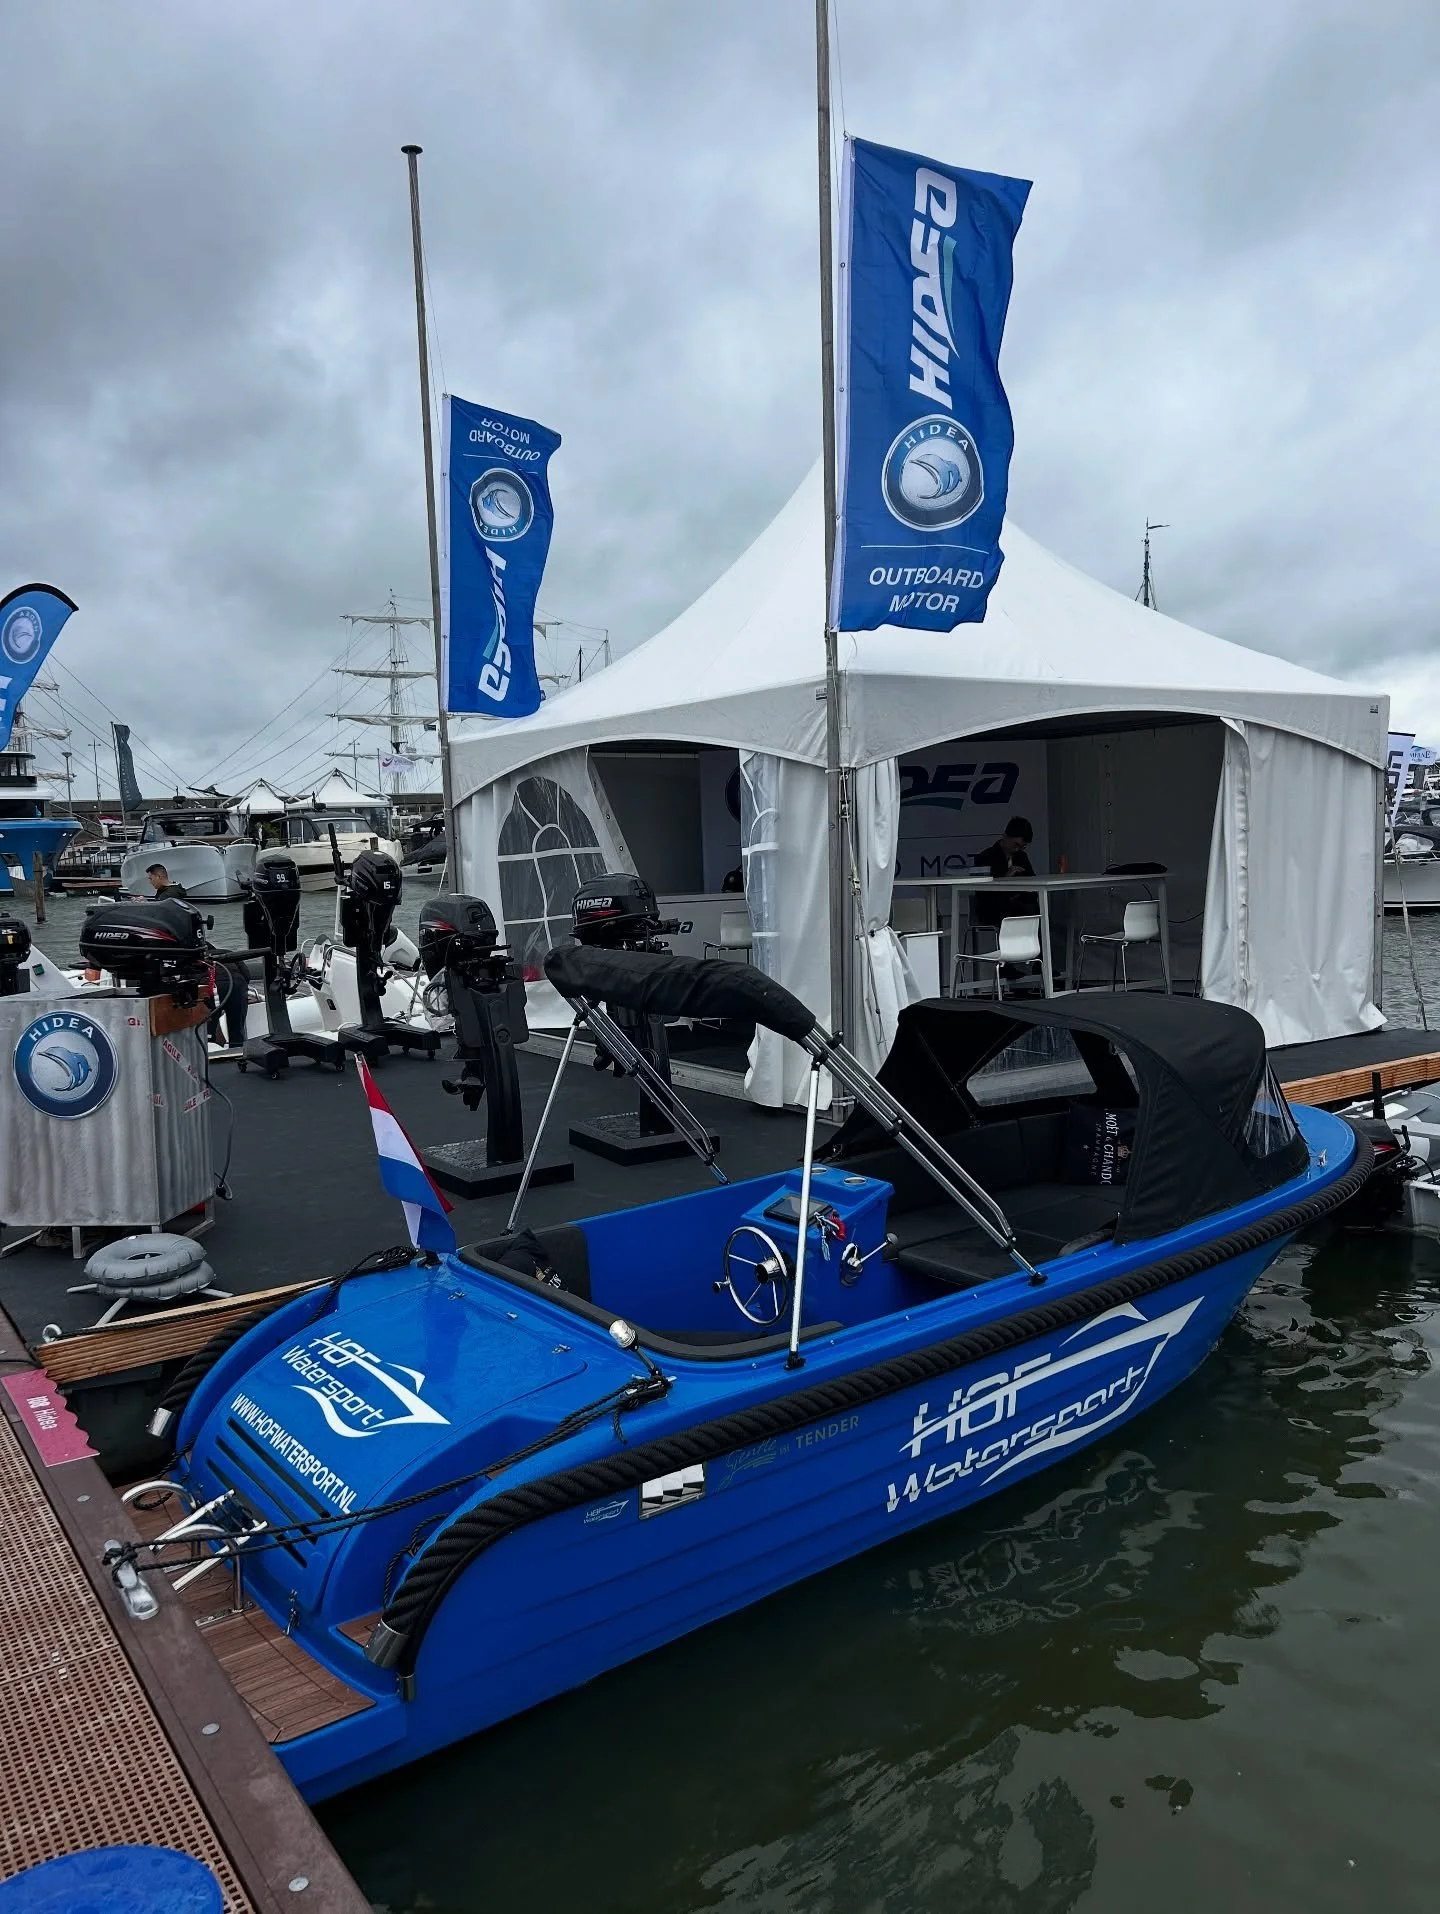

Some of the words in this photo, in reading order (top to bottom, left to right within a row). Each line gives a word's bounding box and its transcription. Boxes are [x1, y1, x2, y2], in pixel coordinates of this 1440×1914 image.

[481, 417, 530, 443] MOTOR
[904, 424, 969, 451] HIDEA
[469, 429, 541, 462] OUTBOARD
[869, 565, 984, 589] OUTBOARD
[383, 881, 391, 889] 15
[575, 897, 613, 910] HIDEA
[29, 1017, 94, 1042] HIDEA
[163, 1039, 181, 1062] AGILE
[309, 1331, 382, 1368] HOF
[281, 1345, 386, 1426] Watersport
[908, 1353, 1052, 1458] HOF
[795, 1415, 860, 1449] TENDER
[886, 1366, 1145, 1513] Watersport
[230, 1393, 358, 1514] WWW.HOFWATERSPORT.NL
